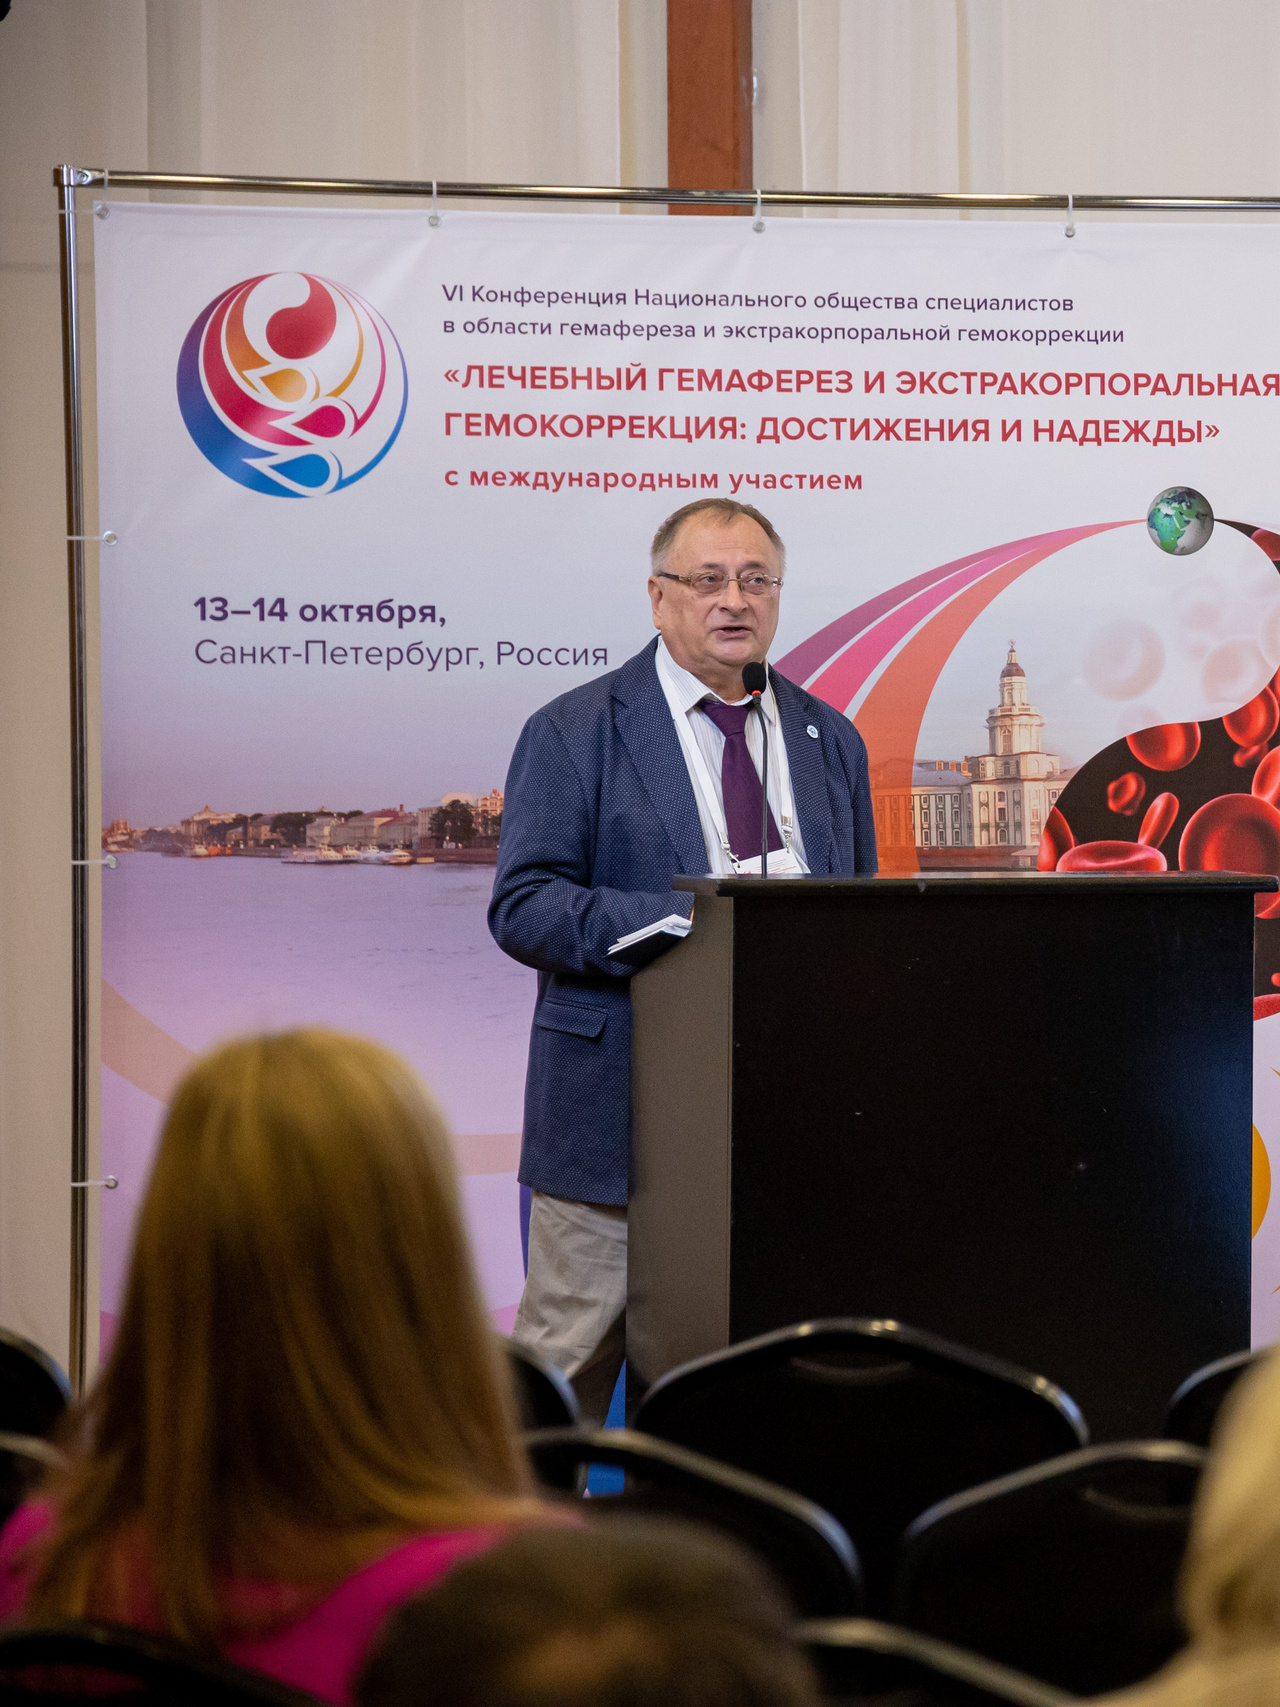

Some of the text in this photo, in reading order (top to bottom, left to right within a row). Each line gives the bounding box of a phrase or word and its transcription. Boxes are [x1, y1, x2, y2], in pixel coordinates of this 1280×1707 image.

[442, 284, 1074, 313] VI Конференция Национального общества специалистов
[443, 316, 1124, 347] в области гемафереза и экстракорпоральной гемокоррекции
[443, 362, 1280, 397] «ЛЕЧЕБНЫЙ ГЕМАФЕРЕЗ И ЭКСТРАКОРПОРАЛЬНАЯ
[444, 412, 1220, 447] ГЕМОКОРРЕКЦИЯ: ДОСТИЖЕНИЯ И НАДЕЖДЫ»
[444, 469, 863, 495] с международным участием
[193, 596, 446, 629] 13–14 октября,
[194, 638, 608, 671] Санкт-Петербург, Россия
